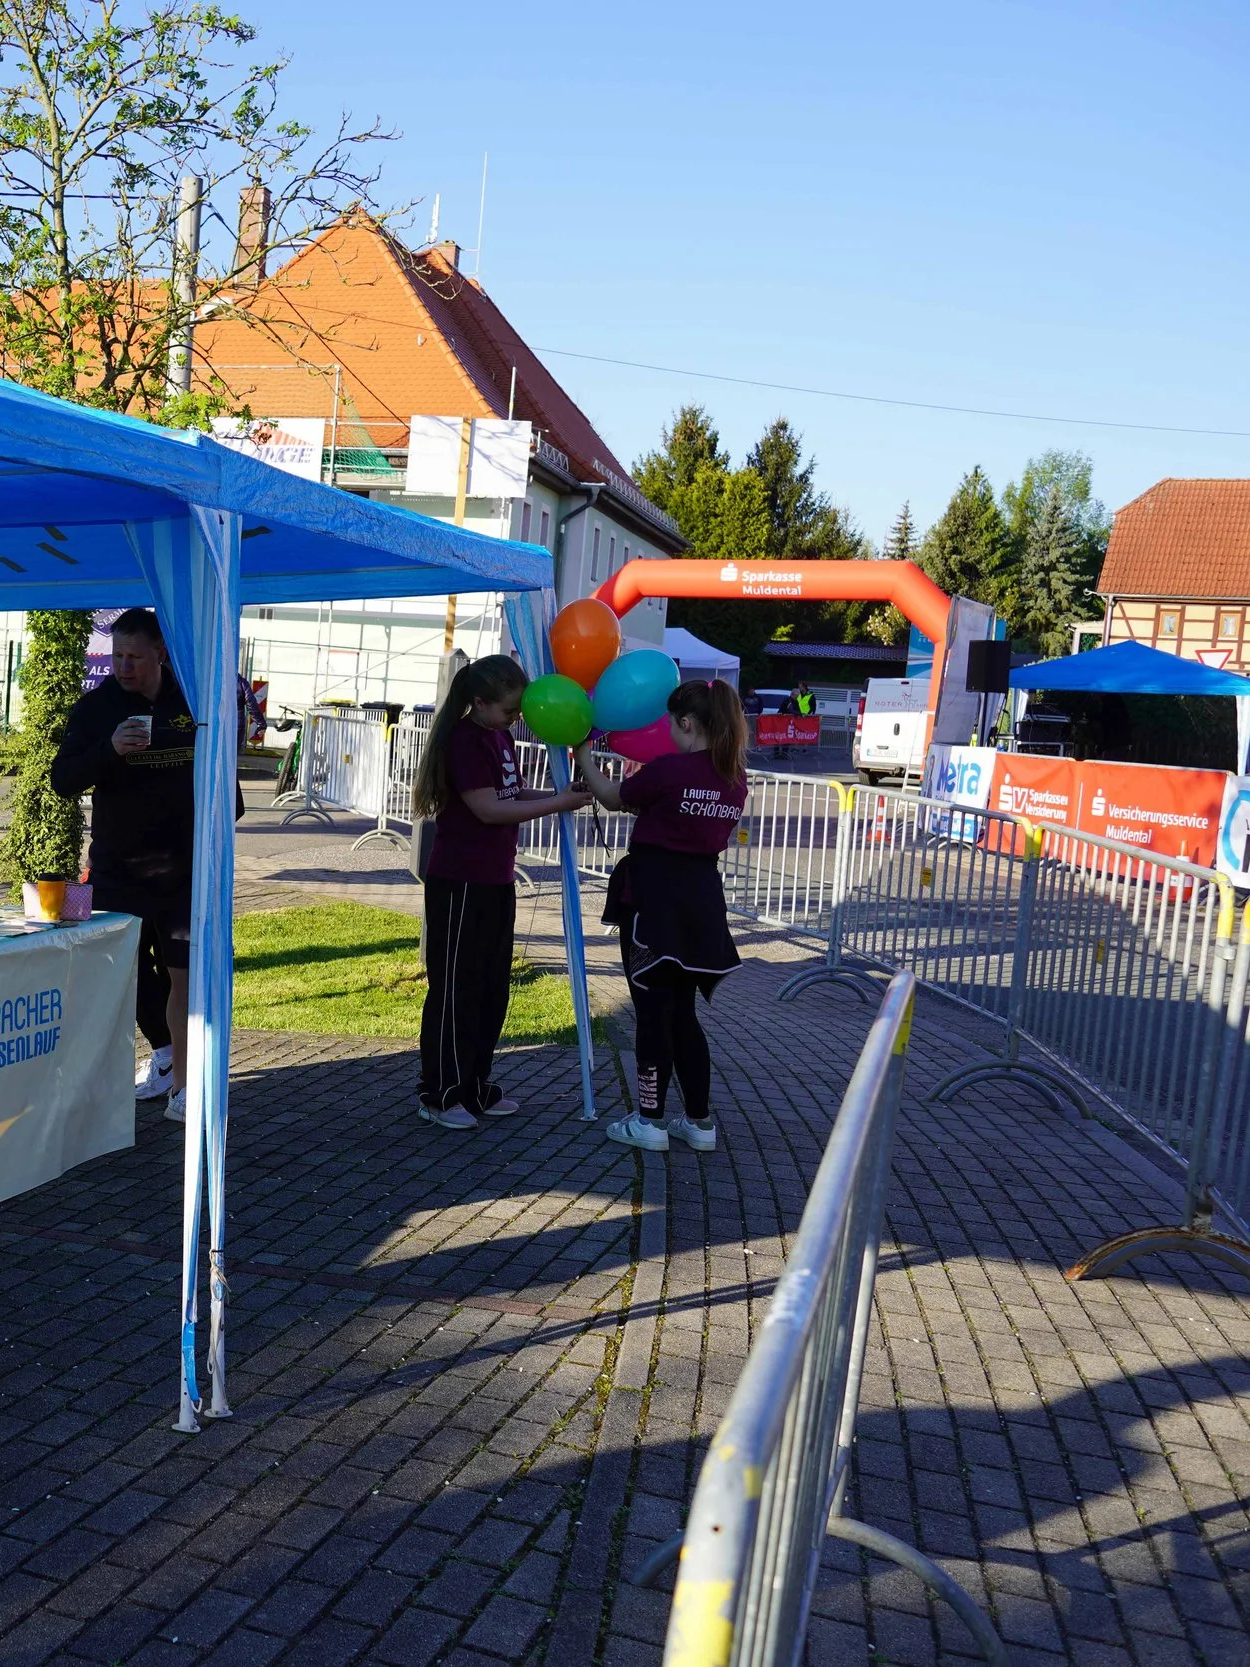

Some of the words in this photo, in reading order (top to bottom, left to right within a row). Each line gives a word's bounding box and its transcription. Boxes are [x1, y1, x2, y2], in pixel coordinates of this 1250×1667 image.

[741, 570, 802, 584] Sparkasse
[742, 585, 802, 595] Muldental
[97, 607, 128, 629] SERM
[88, 665, 110, 676] ALS
[683, 788, 721, 801] LAUFEND
[1109, 803, 1209, 830] Versicherungsservice
[1106, 824, 1153, 844] Muldental
